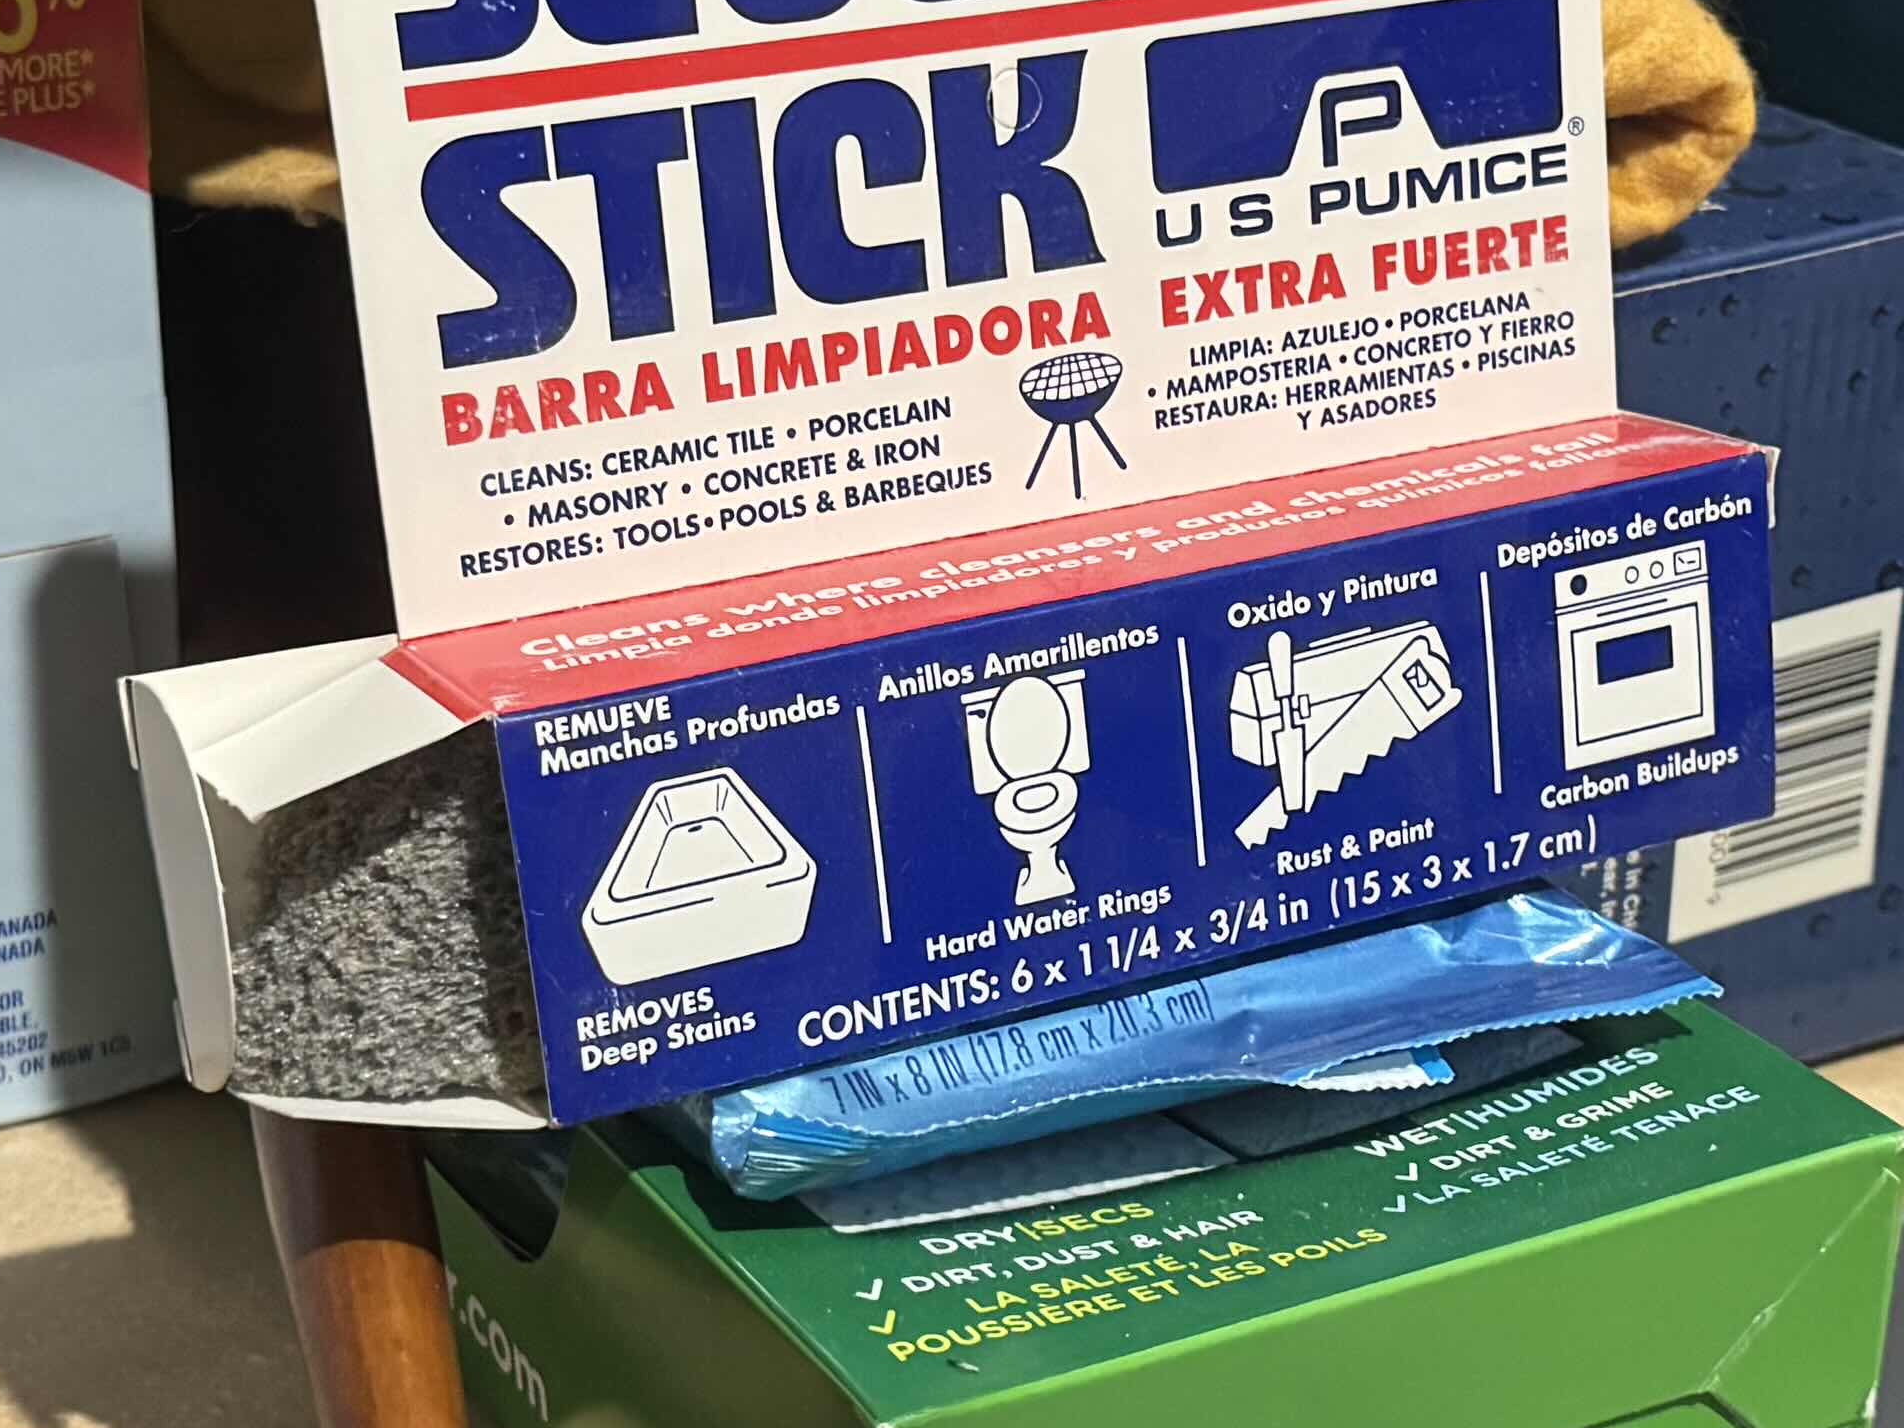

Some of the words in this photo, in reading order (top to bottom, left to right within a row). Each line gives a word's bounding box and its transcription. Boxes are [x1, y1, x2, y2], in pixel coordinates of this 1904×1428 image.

[419, 49, 1109, 371] STICK
[1160, 252, 1347, 328] EXTRA
[1372, 214, 1571, 293] FUERTE
[441, 362, 675, 447] BARRA
[703, 289, 1112, 406] LIMPIADORA
[1165, 352, 1332, 401] MAMPOSTERIA
[1353, 325, 1473, 368] CONCRETO
[1478, 324, 1496, 346] Y
[1500, 309, 1576, 342] FIERRO
[1189, 336, 1274, 369] LIMPIA:
[1281, 317, 1380, 353] AZULEJO
[1399, 290, 1532, 331] PORCELANA
[1153, 392, 1280, 430] RESTAURA:
[1284, 357, 1456, 407] HERRAMIENTAS
[1476, 336, 1577, 373] PISCINAS
[1296, 411, 1313, 432] Y
[1318, 387, 1438, 430] ASADORES
[480, 460, 593, 498] CLEANS:
[601, 435, 720, 476] CERAMIC
[726, 426, 776, 457] TILE
[808, 395, 953, 441] PORCELAIN
[527, 482, 668, 528] MASONRY
[703, 452, 838, 497] CONCRETE
[846, 447, 867, 472] &
[874, 434, 942, 467] IRON
[460, 531, 605, 578] RESTORES:
[816, 489, 837, 514] &
[844, 461, 994, 509] BARBEQUES
[519, 609, 707, 659] Cleans
[724, 573, 904, 617] where
[918, 523, 1162, 578] cleansers
[1177, 500, 1276, 532] and
[1290, 446, 1526, 512] chemicals
[1523, 432, 1616, 465] fail
[1496, 520, 1621, 569] Depósitos
[1626, 513, 1659, 541] de
[1661, 492, 1753, 533] Carbón
[1226, 590, 1313, 630] Oxido
[1317, 589, 1338, 619] y
[1343, 567, 1440, 608] Pintura
[877, 662, 976, 704] Anillos
[982, 620, 1161, 680] Amarillentos
[534, 695, 673, 747] REMUEVE
[539, 726, 679, 777] Manchas
[686, 693, 842, 746] Profundas
[1539, 771, 1632, 812] Carbon
[1634, 743, 1740, 789] Buildups
[1276, 844, 1333, 877] Rust
[1340, 833, 1363, 859] &
[1367, 817, 1436, 855] Paint
[794, 966, 1002, 1049] CONTENTS:
[1010, 959, 1034, 995] 6
[1042, 959, 1070, 985] x
[1173, 927, 1198, 953] x
[1208, 897, 1271, 949] 3/4
[1276, 892, 1312, 928] in
[1328, 875, 1382, 920] (15
[1389, 871, 1414, 899] x
[1421, 853, 1444, 890] 3
[1450, 857, 1475, 883] x
[1482, 830, 1533, 873] 1.7
[1537, 812, 1599, 862] cm)
[924, 919, 999, 963] Hard
[1002, 902, 1092, 942] Water
[1096, 884, 1173, 924] Rings
[575, 986, 716, 1043] REMOVES
[580, 1034, 659, 1072] Deep
[664, 1008, 758, 1055] Stains
[819, 1073, 847, 1116] 7
[849, 1069, 884, 1113] IN
[886, 1073, 909, 1103] x
[905, 1054, 932, 1097] 8
[929, 1047, 972, 1094] IN
[967, 1027, 1034, 1089] (17.8
[1039, 1024, 1079, 1065] cm
[1080, 1021, 1098, 1052] x
[1095, 995, 1162, 1044] 20.3
[1165, 978, 1217, 1027] cm)
[1413, 1179, 1472, 1206] LA
[1477, 1132, 1615, 1189] SALETÉ
[1610, 1085, 1762, 1144] TENACE
[1429, 1133, 1514, 1172] DIRT
[1523, 1123, 1556, 1142] &
[1557, 1081, 1675, 1131] GRIME
[886, 1296, 1127, 1363] POUSSIÈRE
[1129, 1278, 1181, 1305] ET
[1188, 1259, 1268, 1289] LES
[1267, 1226, 1389, 1269] POILS
[900, 1264, 1013, 1296] DIRT,
[1021, 1242, 1118, 1274] DUST
[1126, 1233, 1164, 1250] &
[1170, 1208, 1265, 1242] HAIR
[964, 1288, 1028, 1316] LA
[1030, 1253, 1200, 1302] SALETÉ,
[1205, 1238, 1261, 1260] LA
